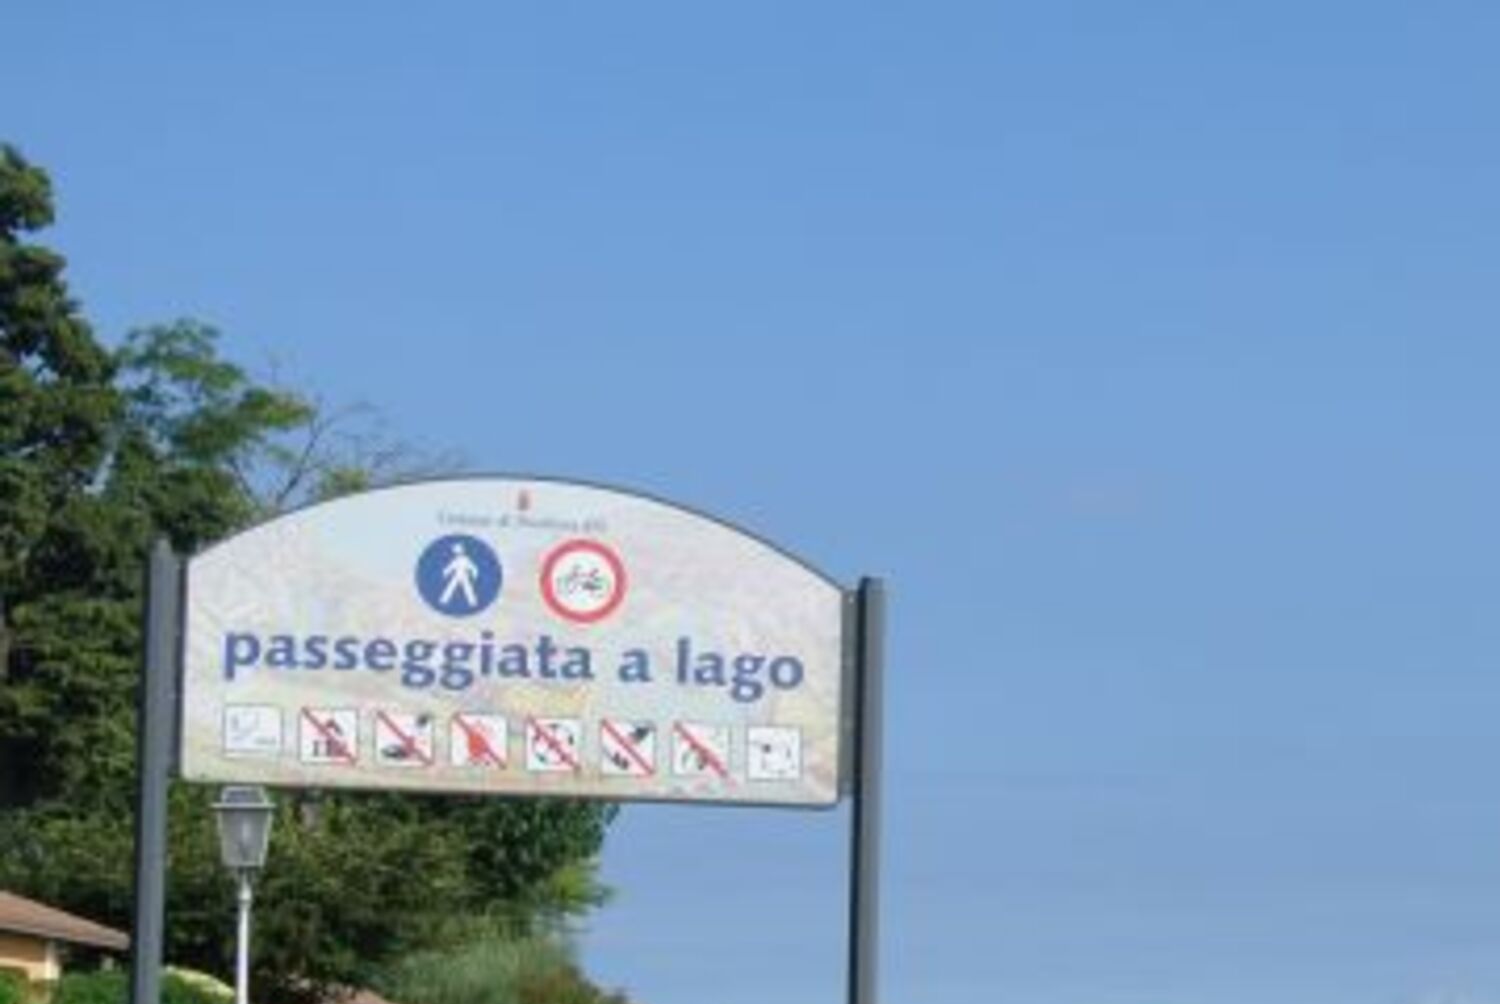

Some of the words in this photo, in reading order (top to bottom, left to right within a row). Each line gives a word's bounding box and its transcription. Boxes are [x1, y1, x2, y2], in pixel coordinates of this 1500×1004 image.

[223, 629, 593, 692] passeggiata
[617, 648, 652, 684] a
[675, 636, 804, 702] lago
